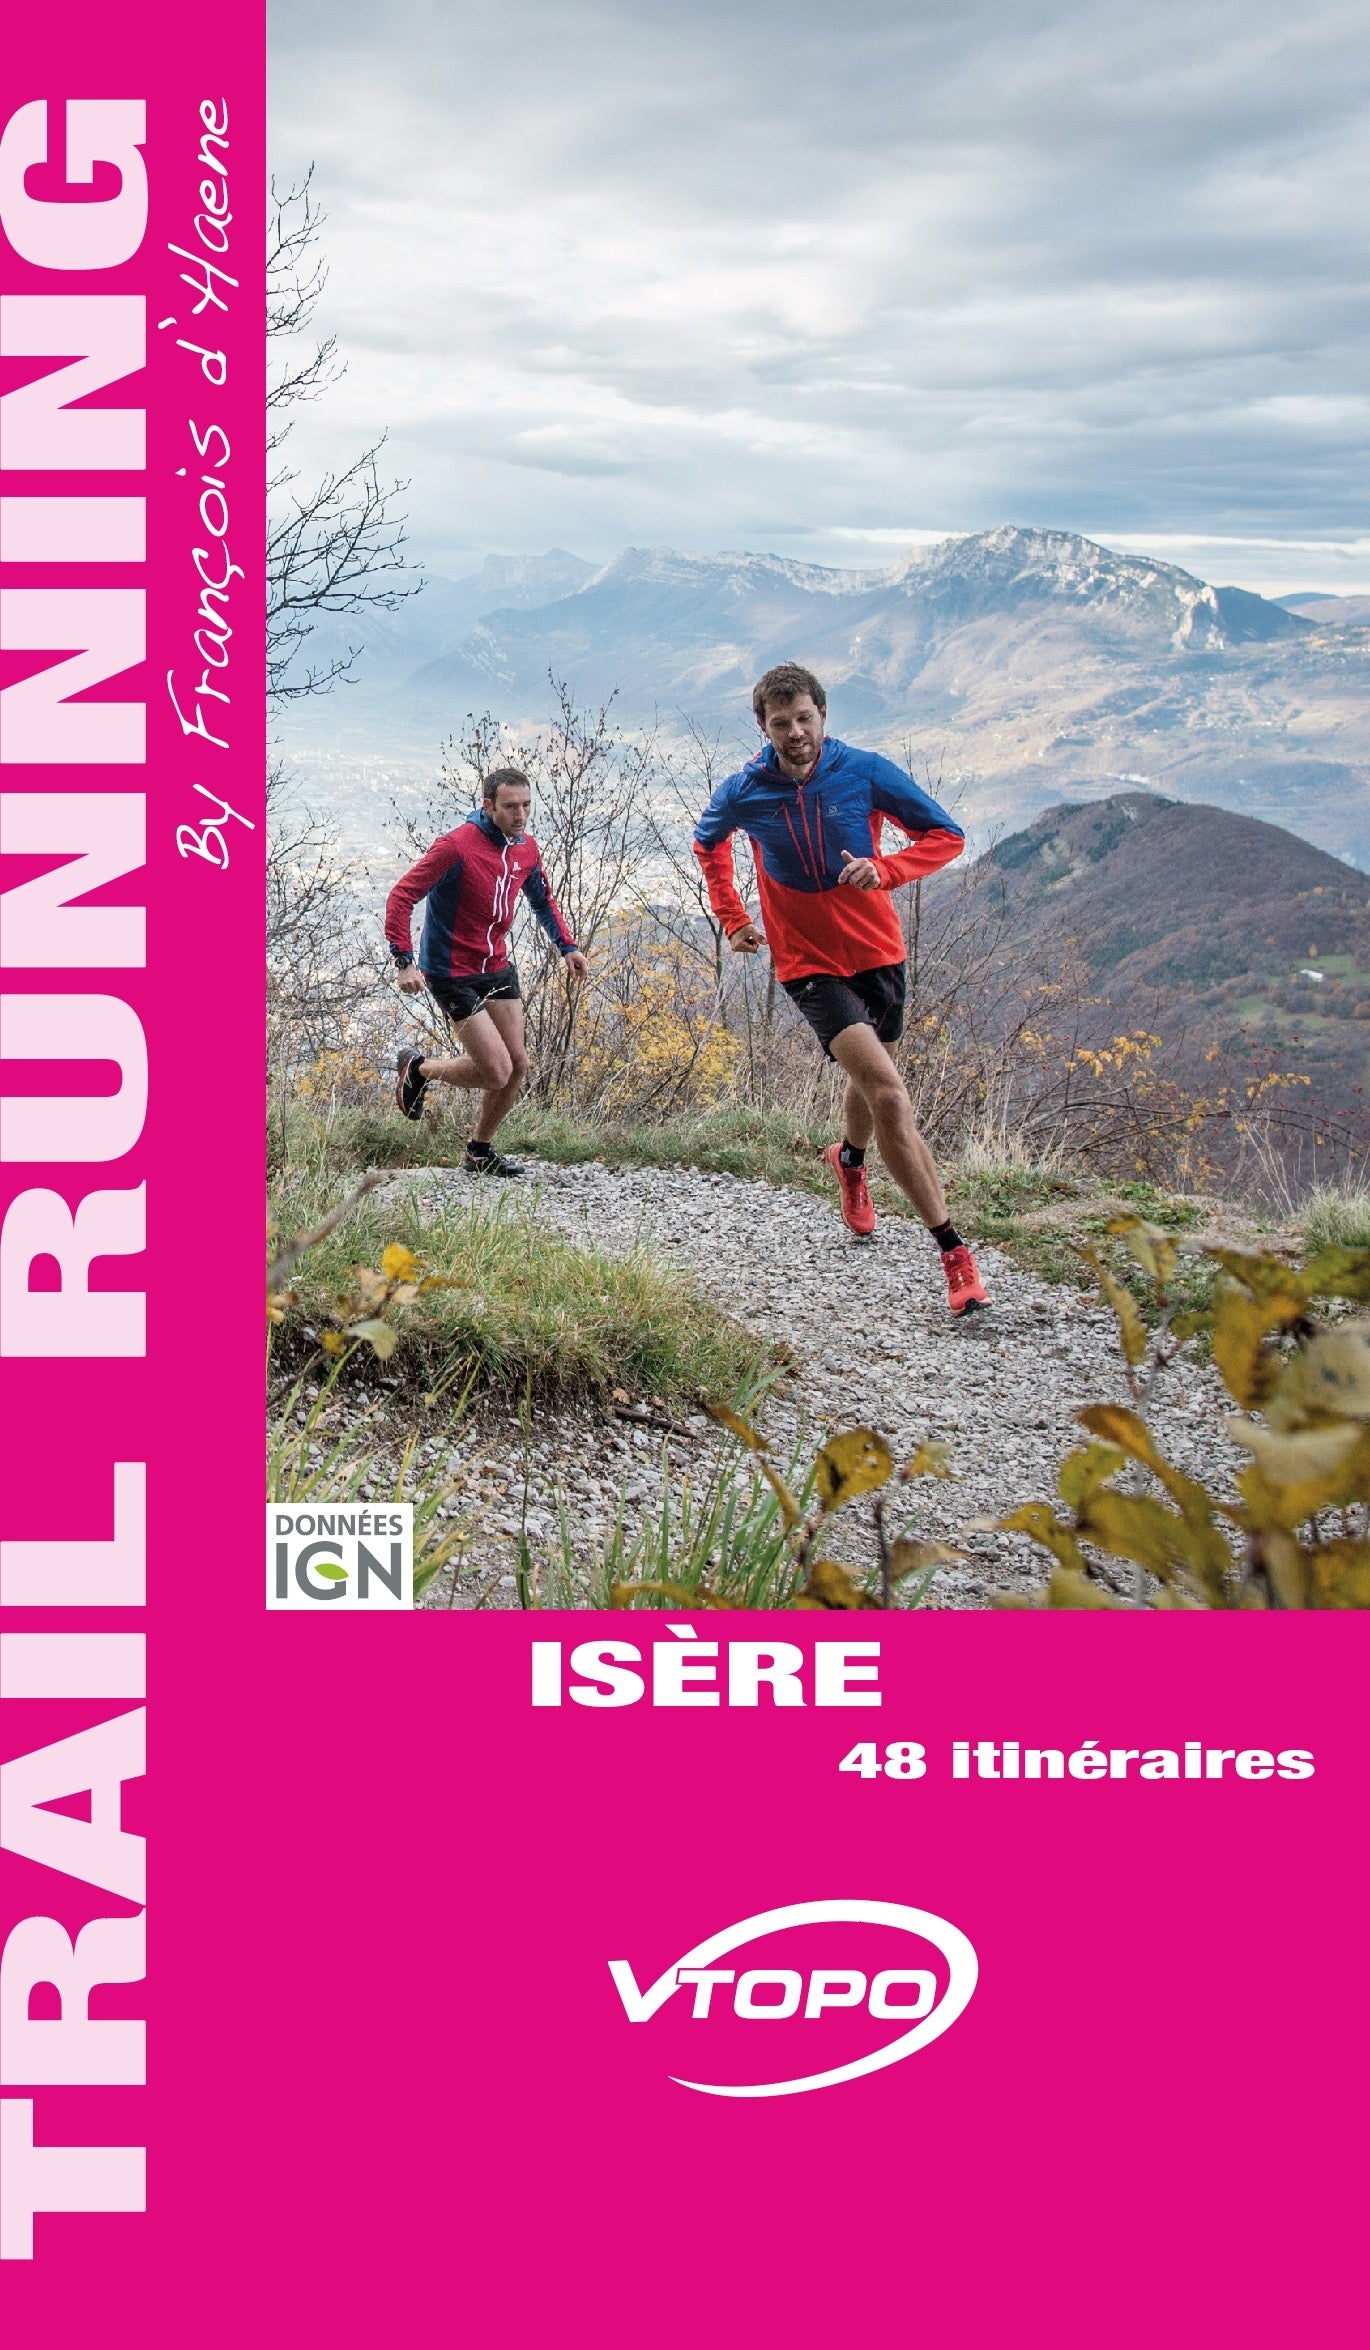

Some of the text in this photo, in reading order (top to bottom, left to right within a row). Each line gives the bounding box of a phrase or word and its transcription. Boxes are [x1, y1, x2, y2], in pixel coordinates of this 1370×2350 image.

[157, 97, 256, 870] By François d'Haene
[0, 99, 149, 2260] TRAIL RUNNING
[275, 1509, 404, 1537] DONNÉES
[275, 1540, 402, 1601] IGN
[531, 1623, 882, 1708] ISÈRE
[838, 1740, 1316, 1780] 48 itinéraires
[607, 1959, 937, 2023] VTOPO
